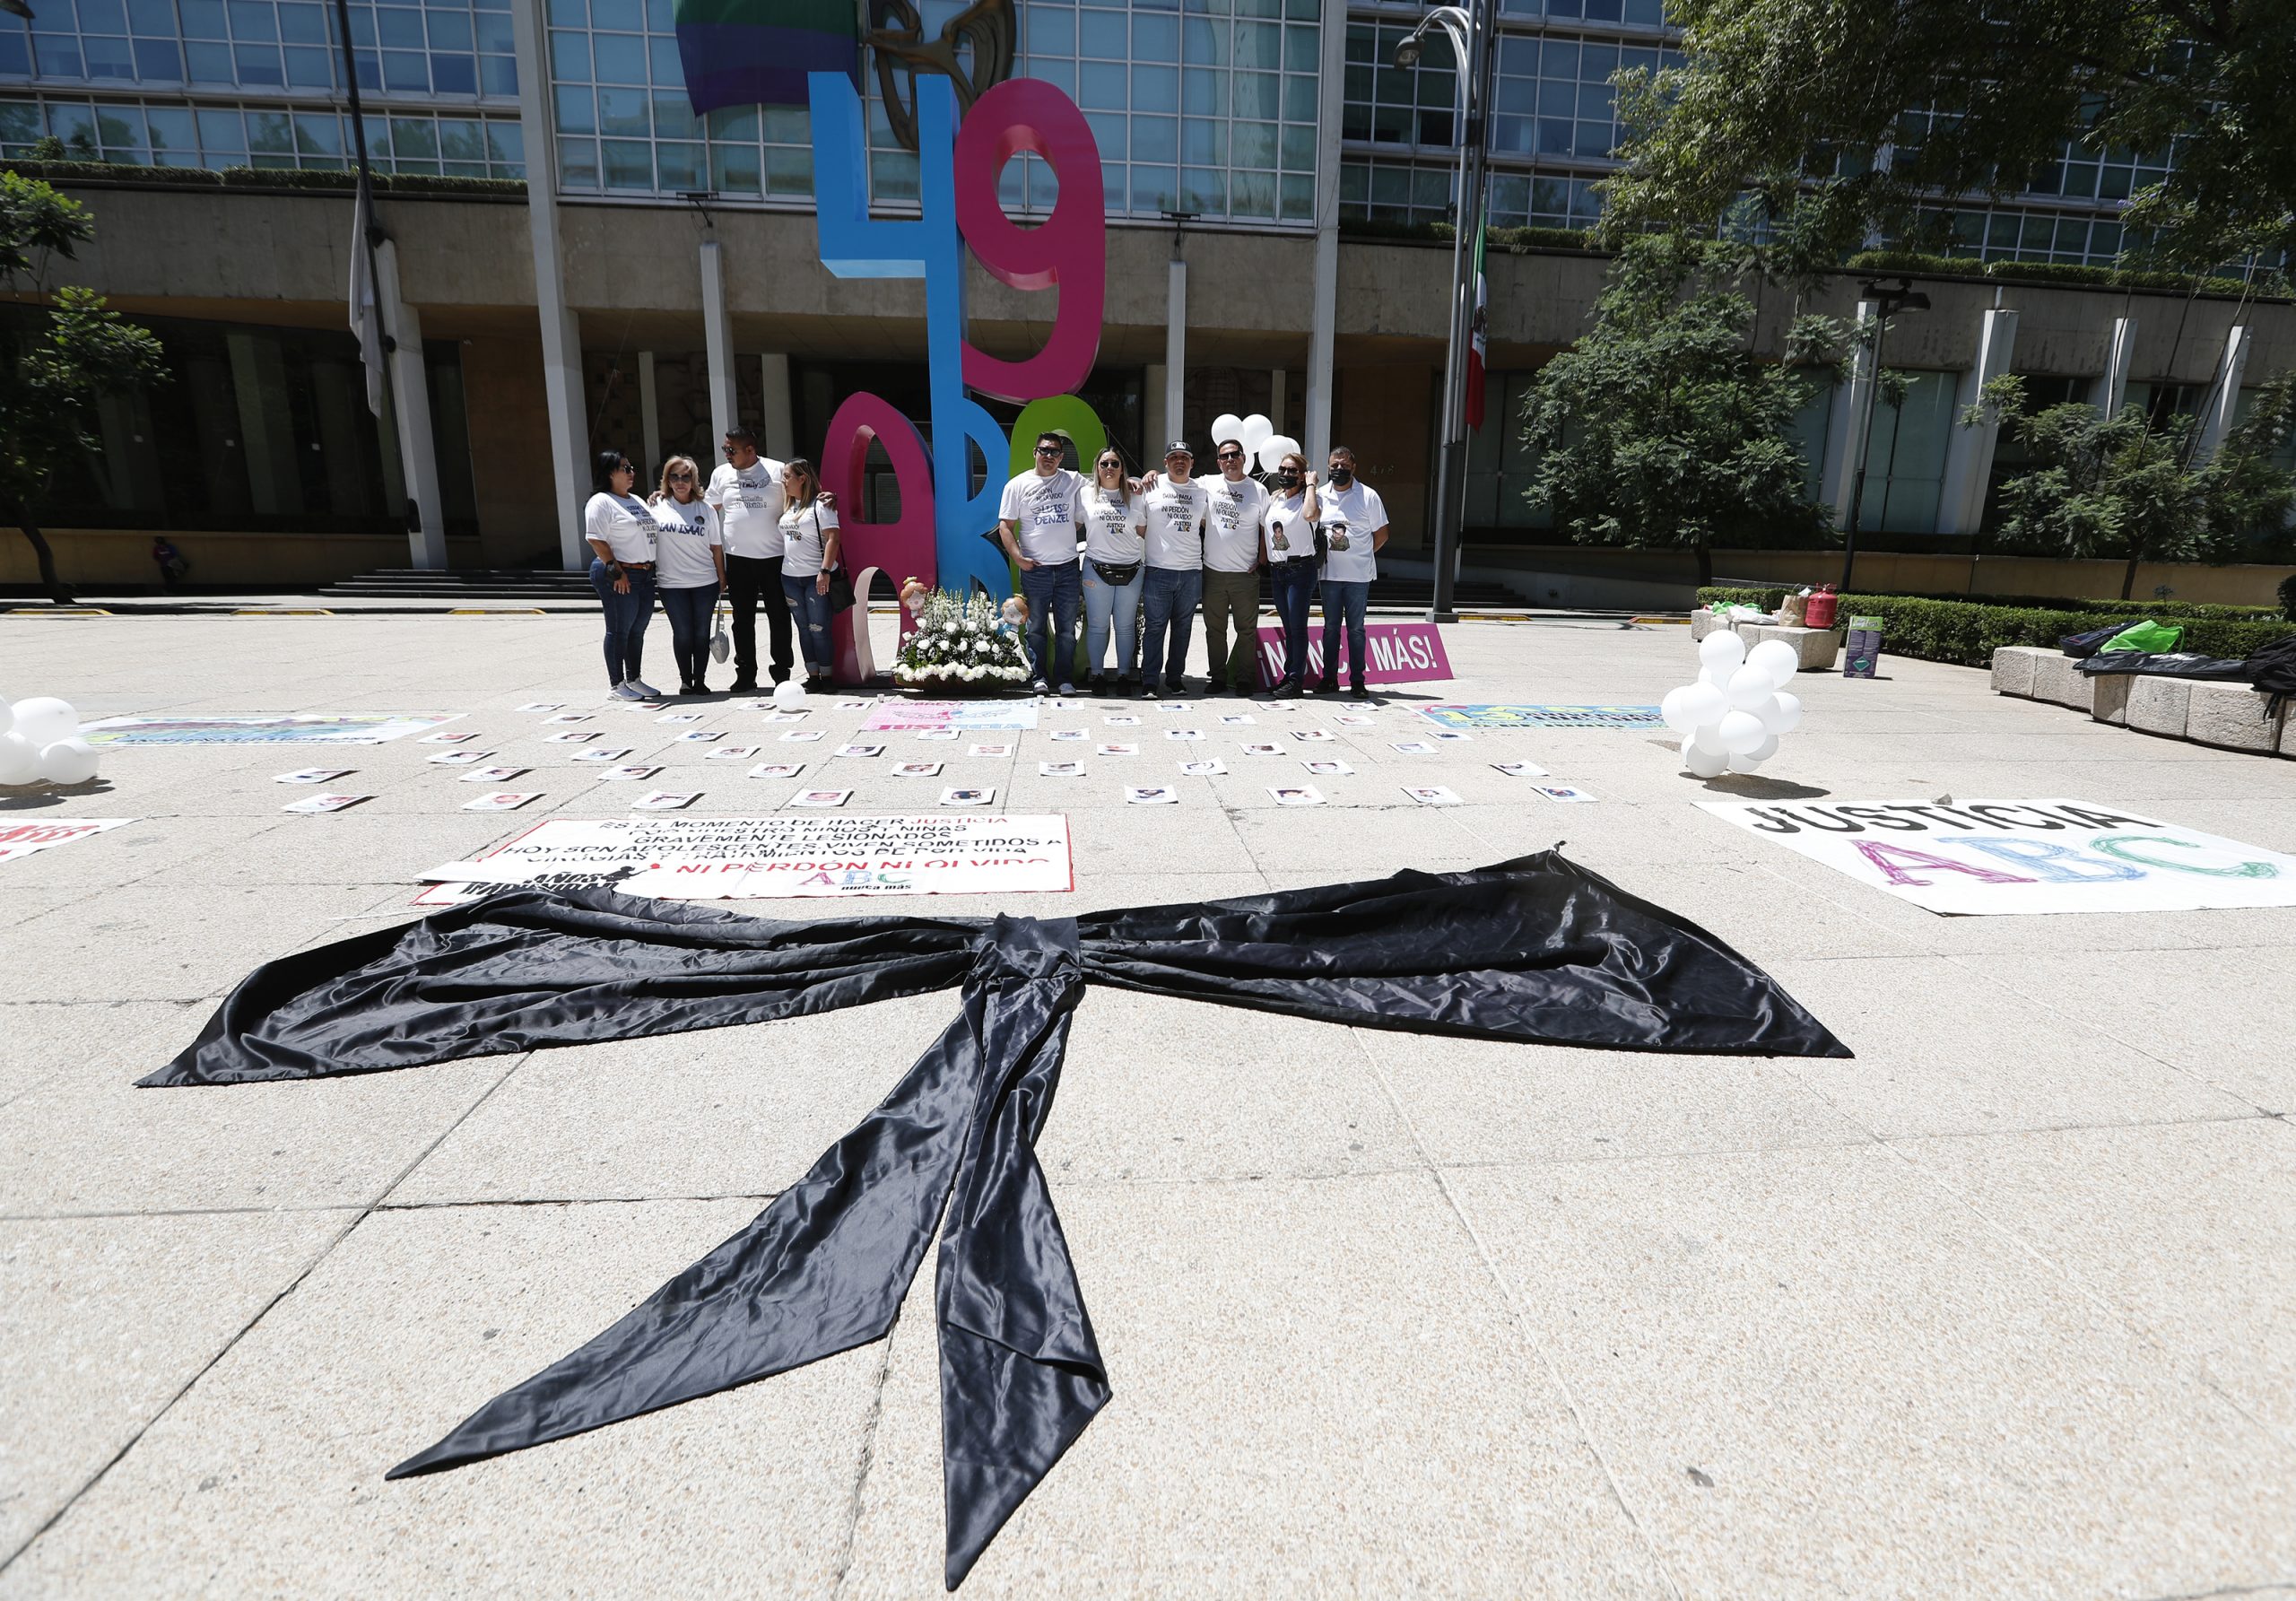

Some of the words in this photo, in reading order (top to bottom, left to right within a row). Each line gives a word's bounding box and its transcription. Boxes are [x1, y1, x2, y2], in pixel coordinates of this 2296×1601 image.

[808, 71, 1105, 402] 49
[1034, 514, 1070, 525] DENZEL
[678, 523, 705, 536] ISAAC
[1369, 627, 1438, 673] MÁS!
[669, 820, 785, 828] MOMENTO
[1743, 804, 2166, 834] JUSTICIA
[634, 834, 796, 844] GRAVEMENTE
[802, 831, 952, 841] LESIONADOS
[503, 846, 560, 854] HOY
[904, 839, 1039, 848] SOMETIDOS
[675, 864, 712, 874] NI
[720, 860, 868, 873] PERDÓN
[880, 860, 913, 869] NI
[1850, 835, 2280, 886] ABC
[524, 872, 604, 883] AÑOS
[797, 870, 912, 885] ABC
